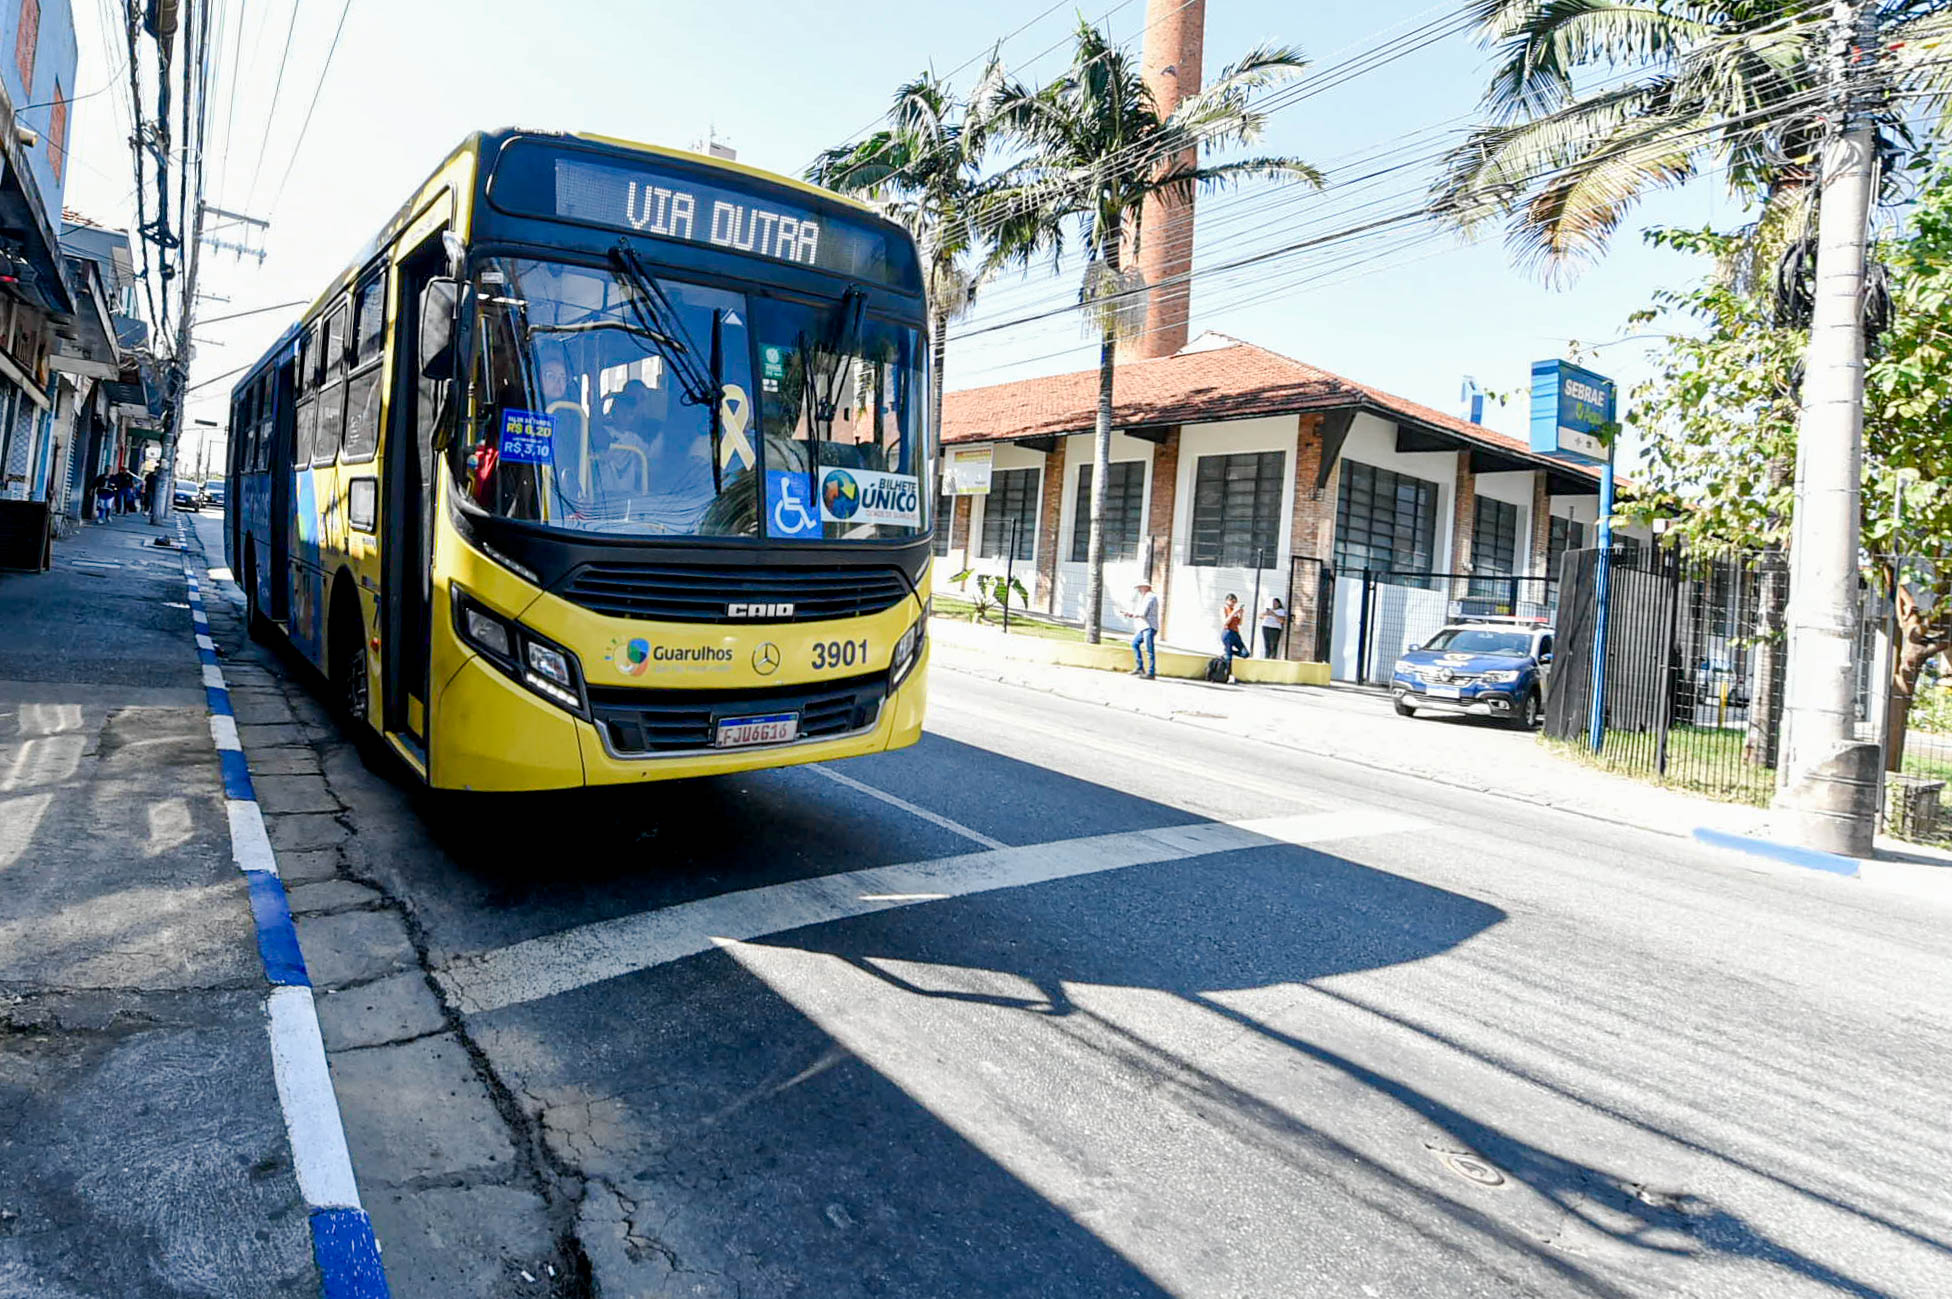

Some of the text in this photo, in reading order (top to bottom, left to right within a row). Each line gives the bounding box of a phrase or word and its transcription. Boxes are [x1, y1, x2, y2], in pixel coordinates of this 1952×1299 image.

[626, 181, 820, 265] VIA DUTRA
[1564, 378, 1606, 407] SEBRAE
[861, 482, 917, 513] ÚNICO
[879, 478, 917, 495] BILHETE
[727, 603, 795, 617] CAIO
[653, 646, 733, 662] Guarulhos
[811, 638, 868, 670] 3901
